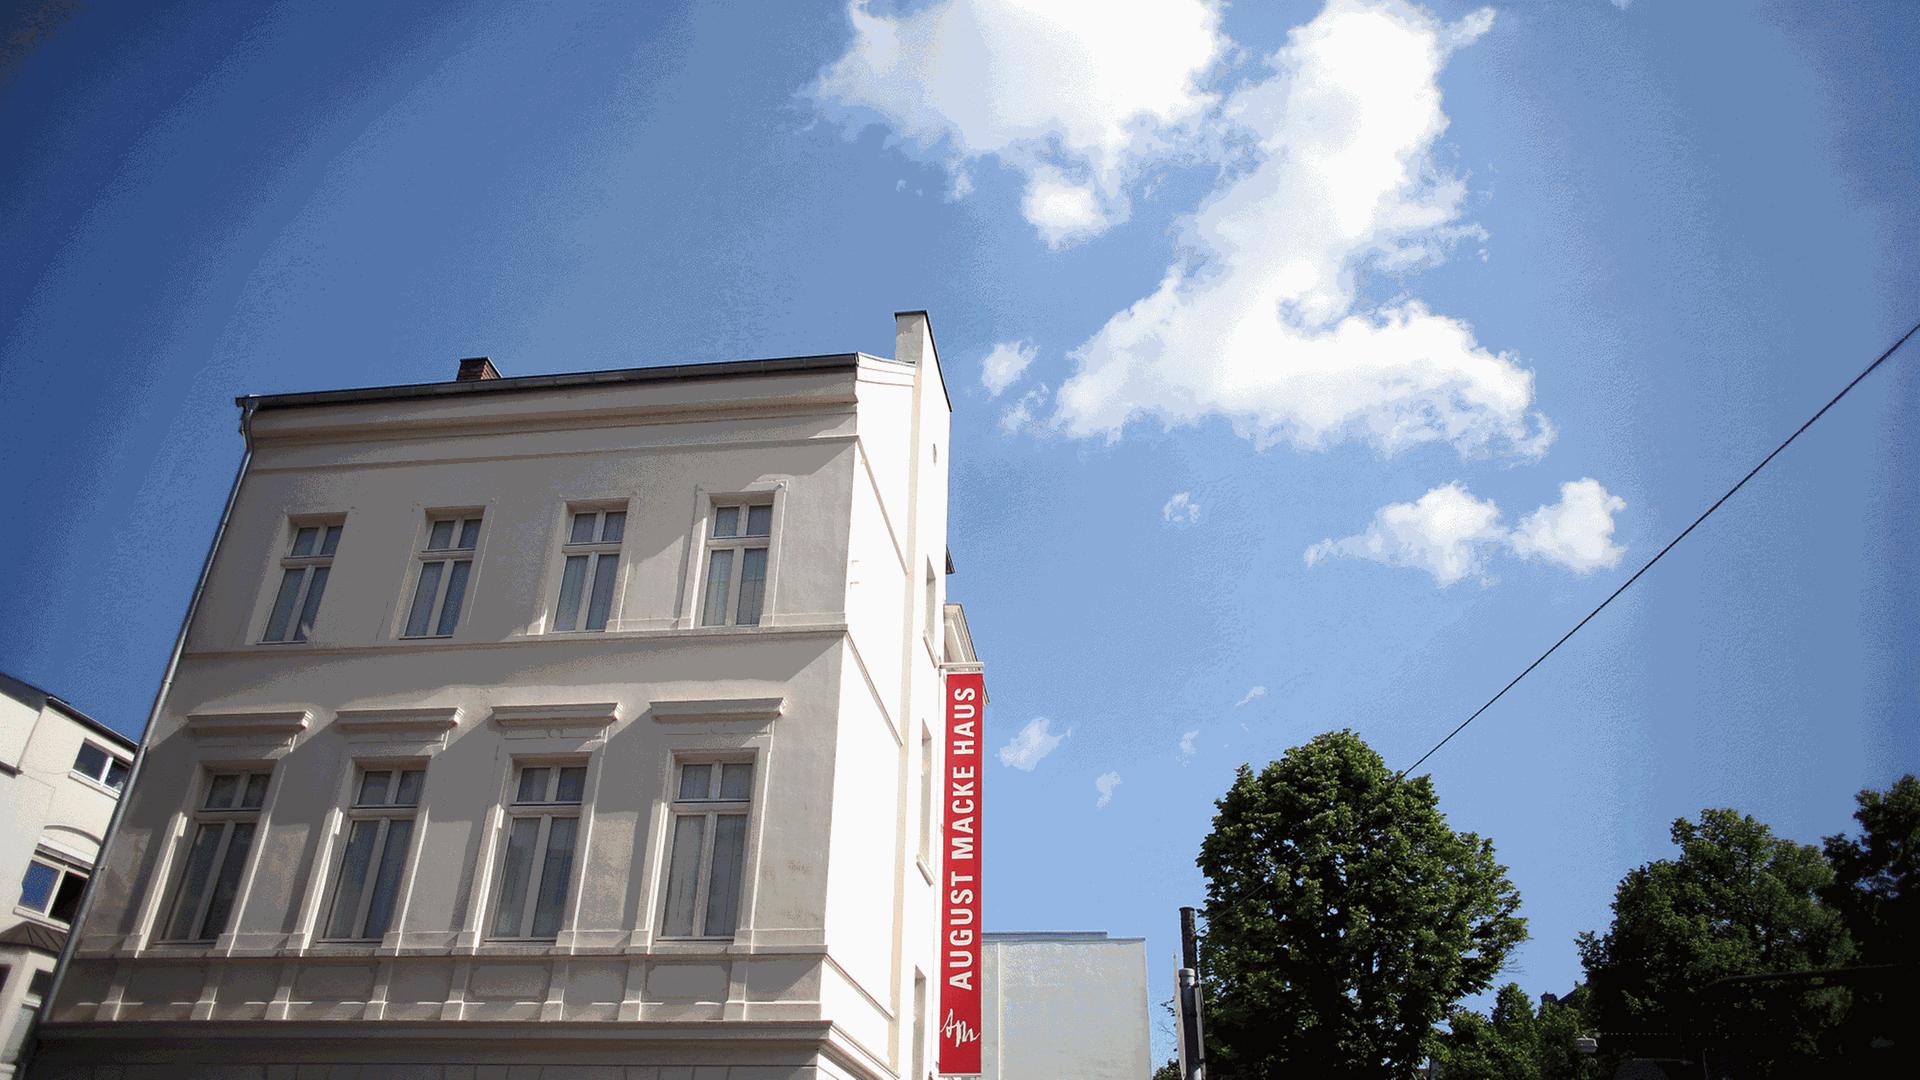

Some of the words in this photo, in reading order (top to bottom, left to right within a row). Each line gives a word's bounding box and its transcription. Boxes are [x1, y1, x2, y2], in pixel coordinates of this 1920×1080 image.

[953, 687, 976, 755] HAUS
[951, 765, 975, 859] MACKE
[949, 870, 973, 990] AUGUST
